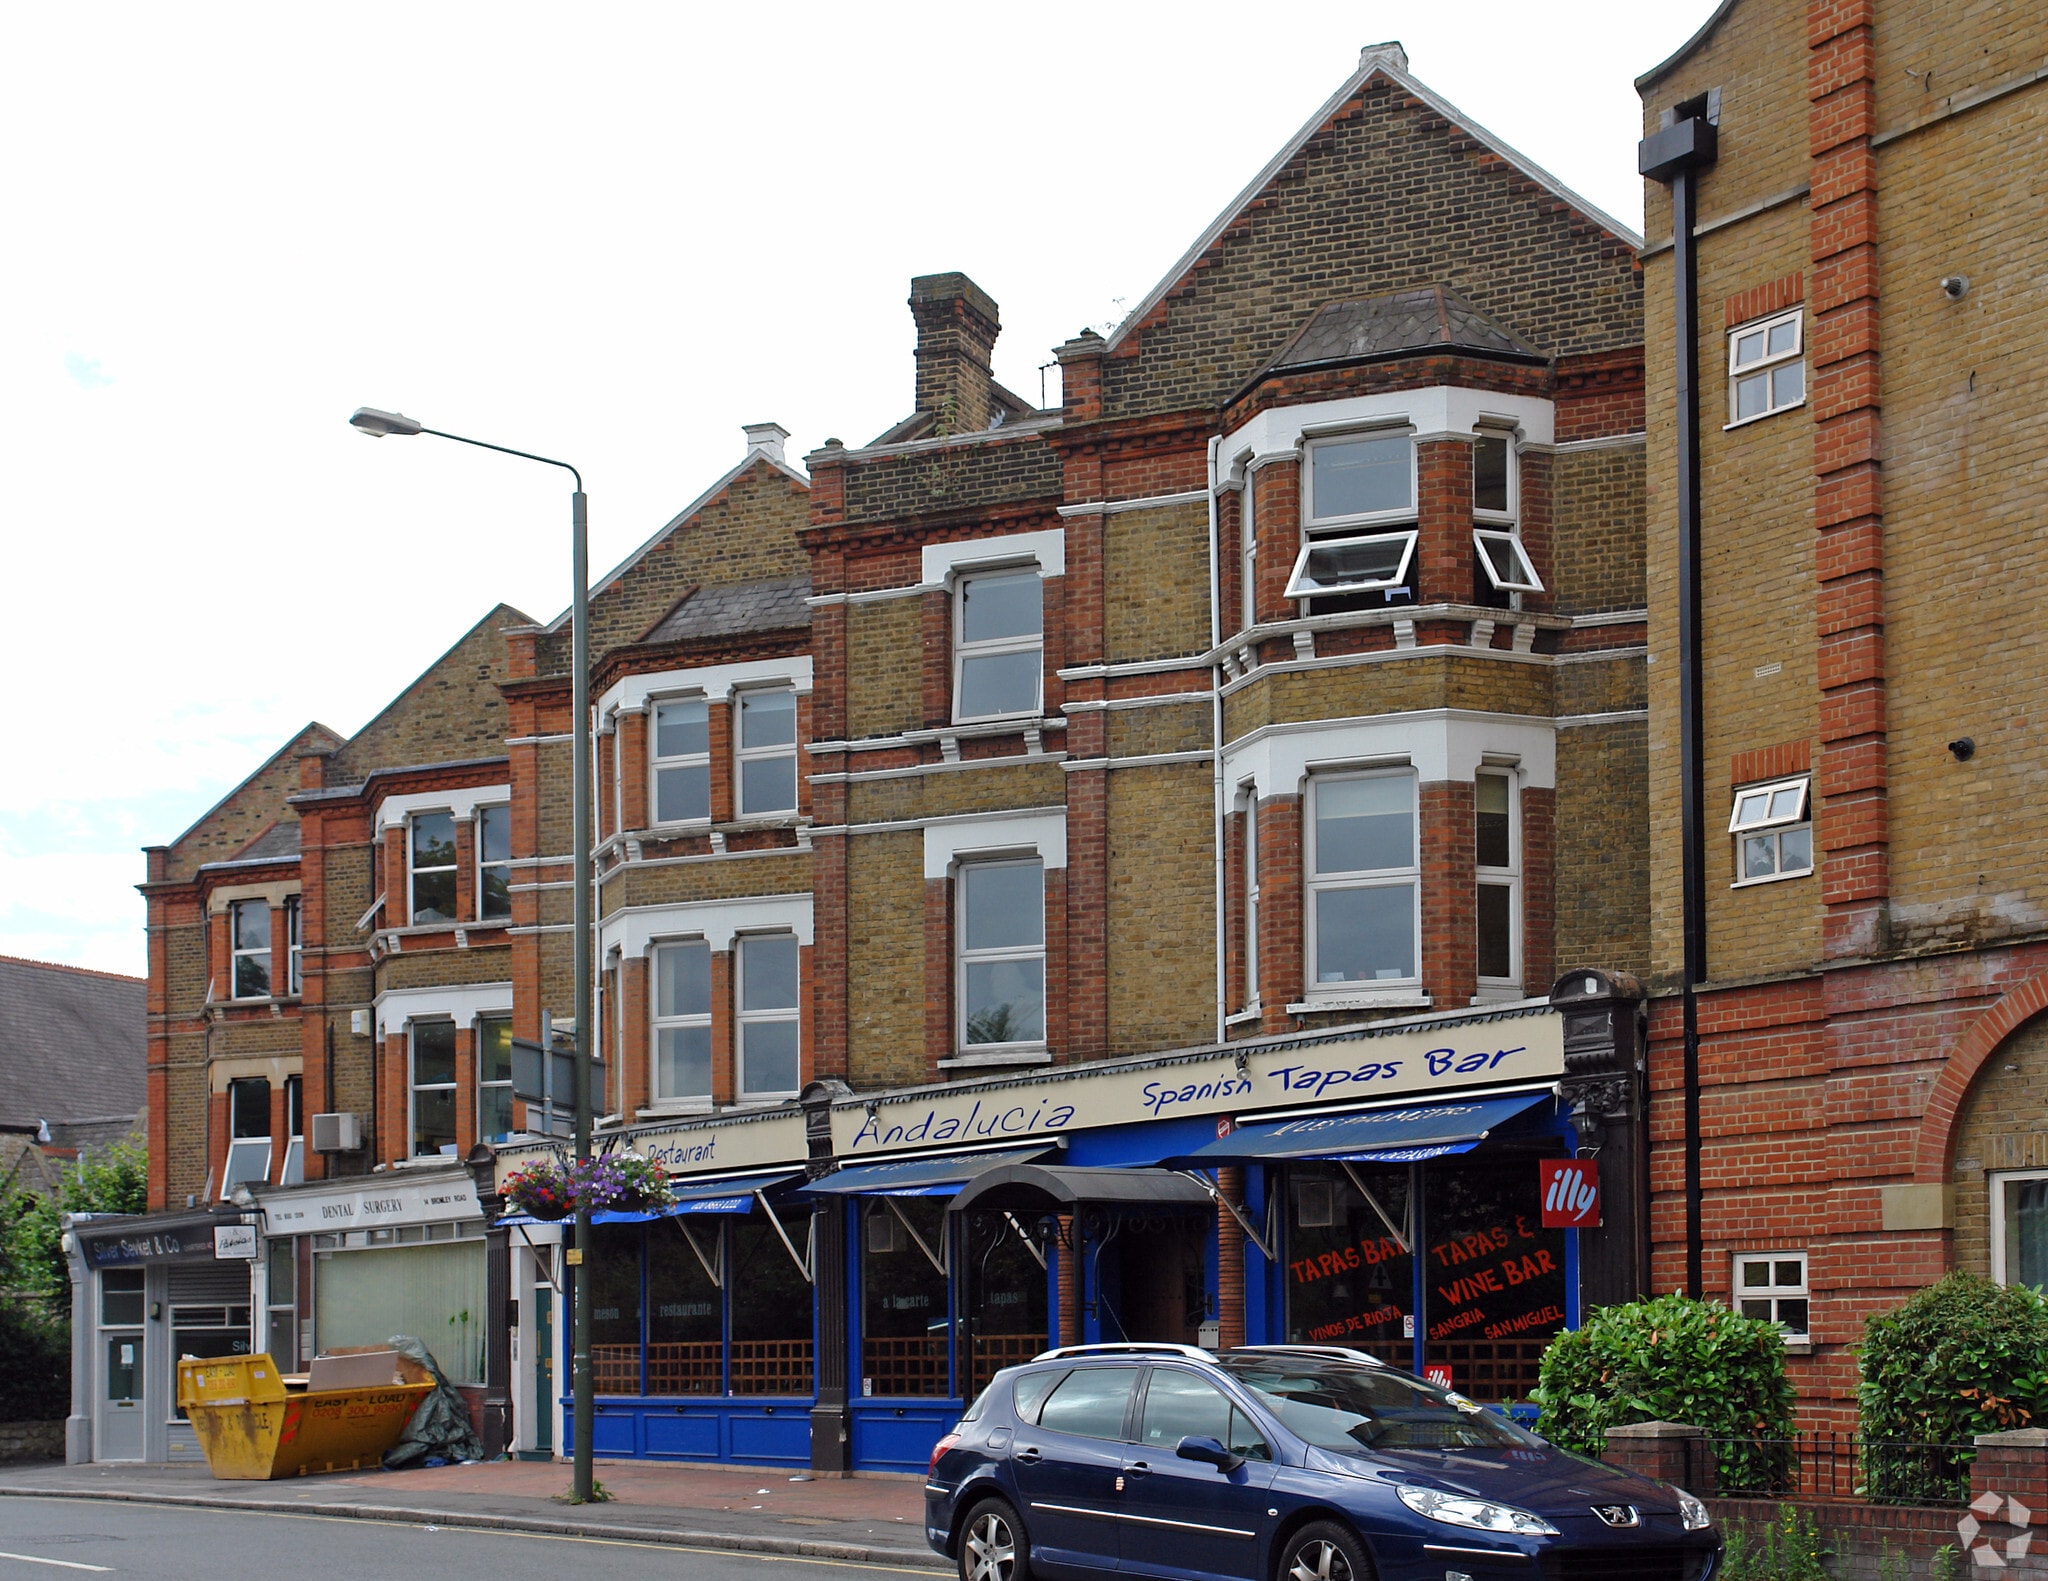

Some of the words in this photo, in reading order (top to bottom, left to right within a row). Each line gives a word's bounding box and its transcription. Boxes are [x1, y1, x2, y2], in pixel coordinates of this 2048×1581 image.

[1142, 1073, 1252, 1116] Spanish
[1268, 1059, 1404, 1097] Tapas
[1423, 1046, 1527, 1077] Bar
[852, 1098, 1075, 1148] Andalucia
[647, 1135, 716, 1166] Restaurant
[321, 1203, 354, 1219] DENTAL
[363, 1199, 403, 1215] SURGERY
[454, 1194, 467, 1202] ROAD
[1545, 1167, 1597, 1222] illy
[93, 1242, 119, 1261] Silver
[121, 1239, 153, 1258] Sevket
[153, 1235, 163, 1255] &
[164, 1235, 180, 1254] Co
[1431, 1226, 1509, 1267] TAPAS
[1290, 1247, 1361, 1285] TAPAS
[1437, 1268, 1505, 1307] WINE
[1501, 1249, 1557, 1287] BAR
[659, 1302, 712, 1317] restaurante
[1308, 1319, 1345, 1342] VINOS
[1346, 1315, 1364, 1332] DE
[1363, 1304, 1403, 1328] RIOJA
[1429, 1307, 1486, 1341] SANGRIA
[1484, 1319, 1513, 1341] SAN
[1514, 1305, 1565, 1333] MIGUEL
[369, 1392, 406, 1405] LOAD
